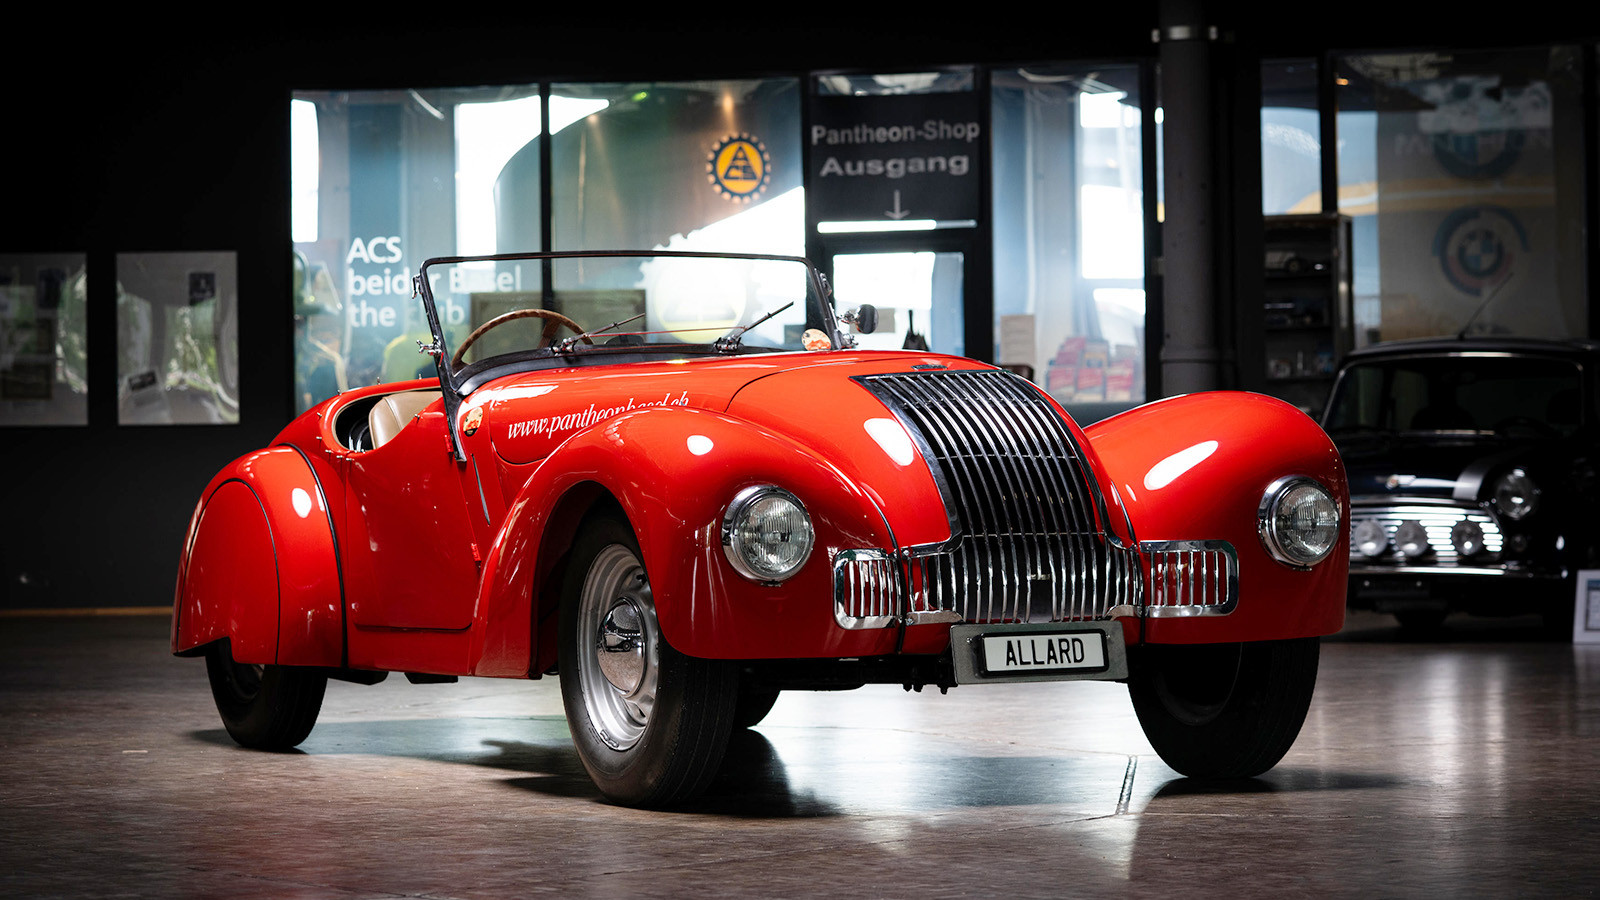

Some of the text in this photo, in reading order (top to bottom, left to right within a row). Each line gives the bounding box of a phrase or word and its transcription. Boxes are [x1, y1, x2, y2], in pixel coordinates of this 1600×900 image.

[811, 119, 981, 146] Pantheon-Shop
[819, 154, 970, 179] Ausgang
[346, 236, 403, 264] ACS
[349, 264, 522, 296] beidr Bel
[350, 300, 397, 328] the
[1005, 637, 1085, 667] ALLARD
